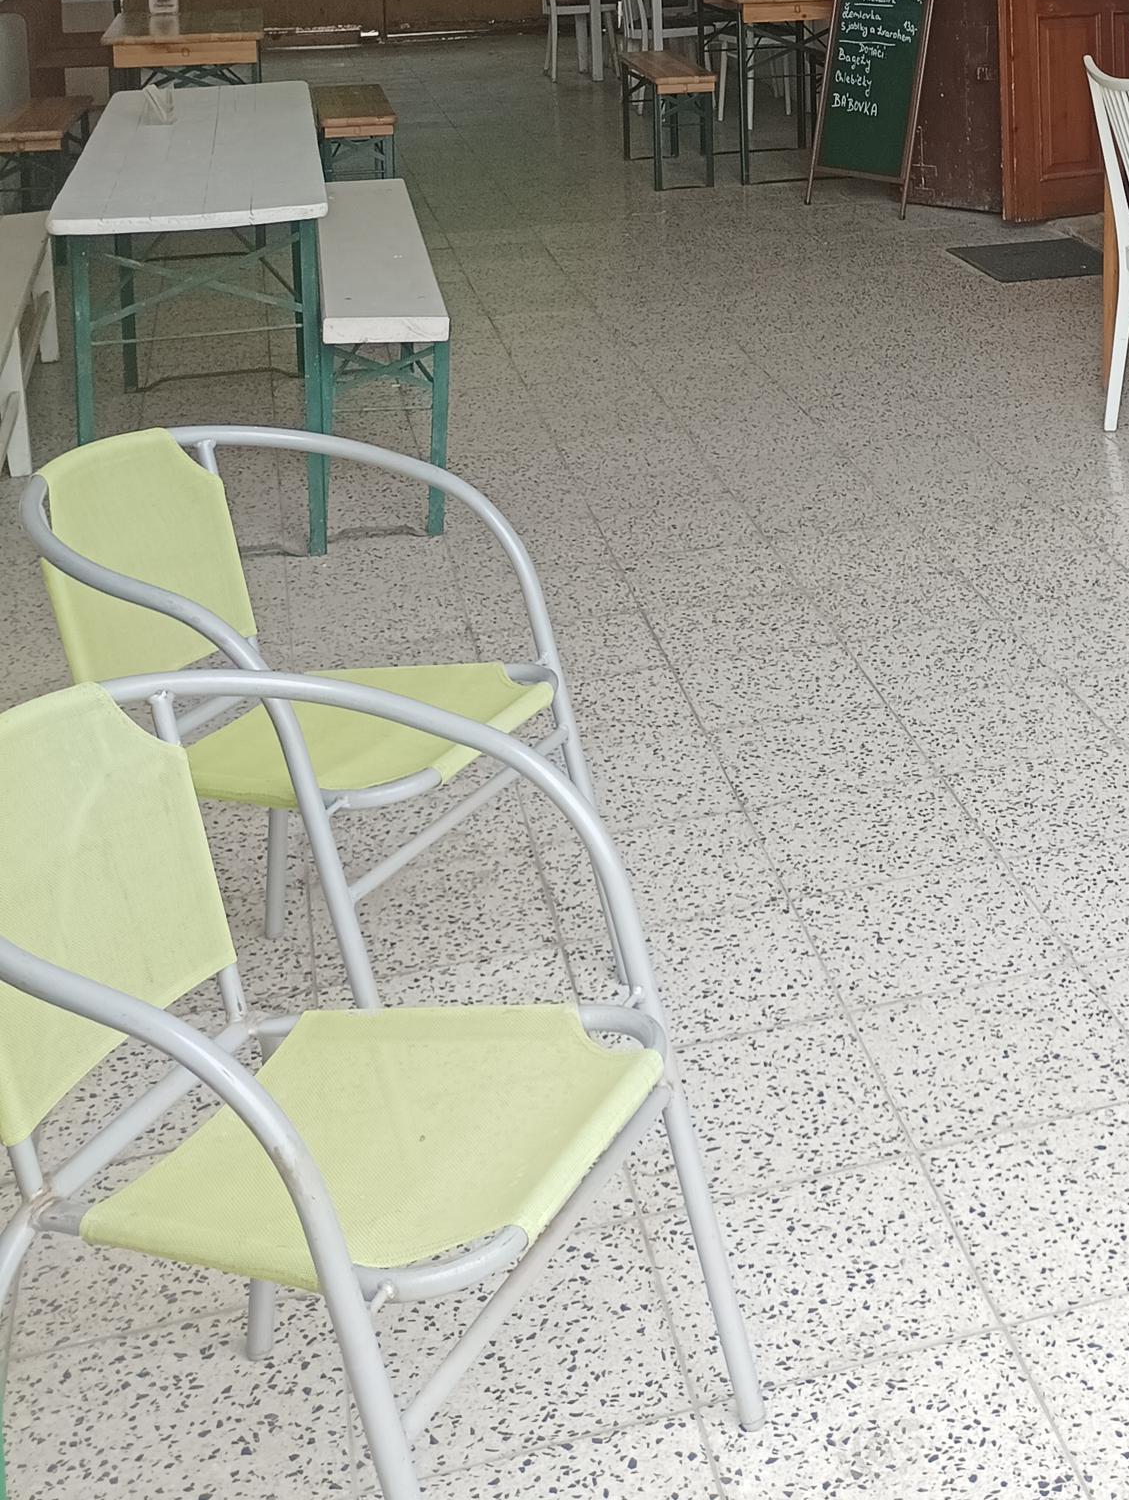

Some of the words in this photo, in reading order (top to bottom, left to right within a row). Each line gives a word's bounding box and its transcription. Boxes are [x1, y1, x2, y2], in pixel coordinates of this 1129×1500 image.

[842, 2, 882, 21] Žemlovka
[846, 21, 868, 37] jablky
[869, 26, 876, 34] a
[877, 25, 912, 43] tvarohem
[838, 47, 871, 73] Bagety
[831, 92, 878, 117] BÁBOVKA
